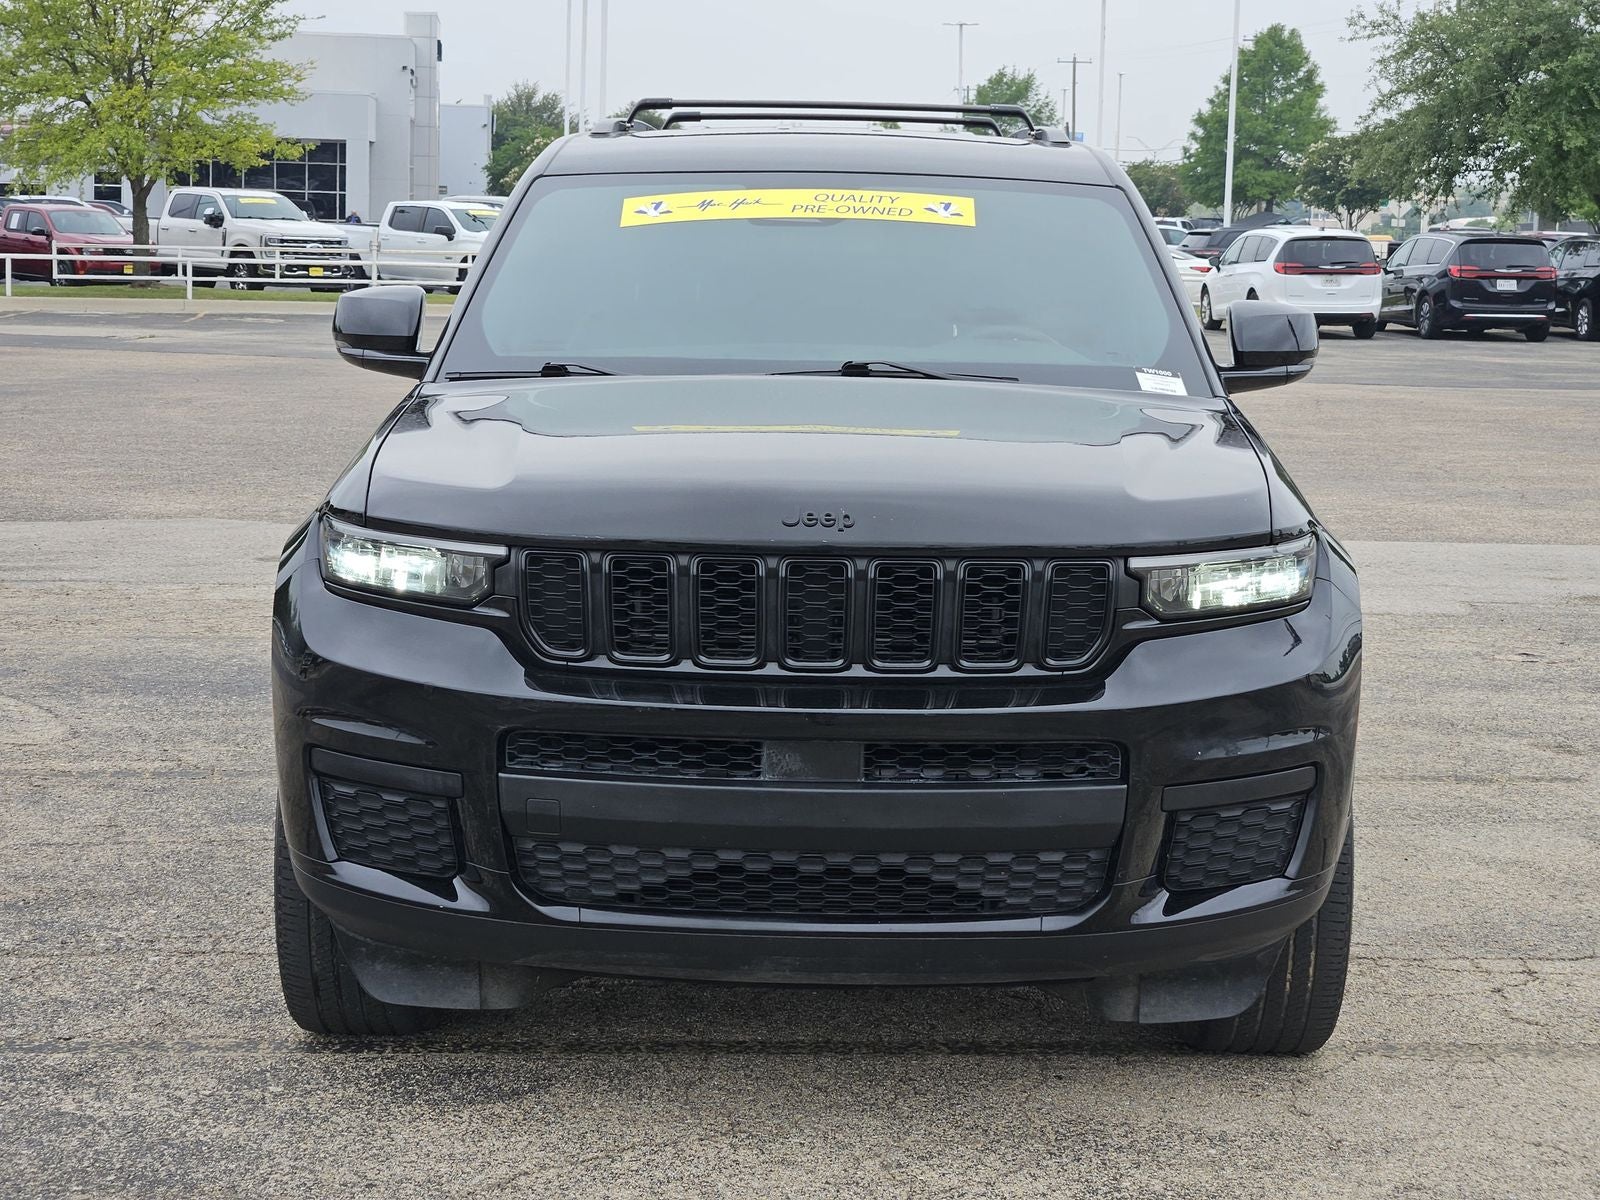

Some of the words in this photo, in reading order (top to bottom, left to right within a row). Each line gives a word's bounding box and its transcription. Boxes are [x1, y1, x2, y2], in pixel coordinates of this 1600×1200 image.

[814, 193, 900, 204] QUALITY
[791, 204, 913, 216] PRE-OWNED
[781, 503, 856, 532] Jeep
